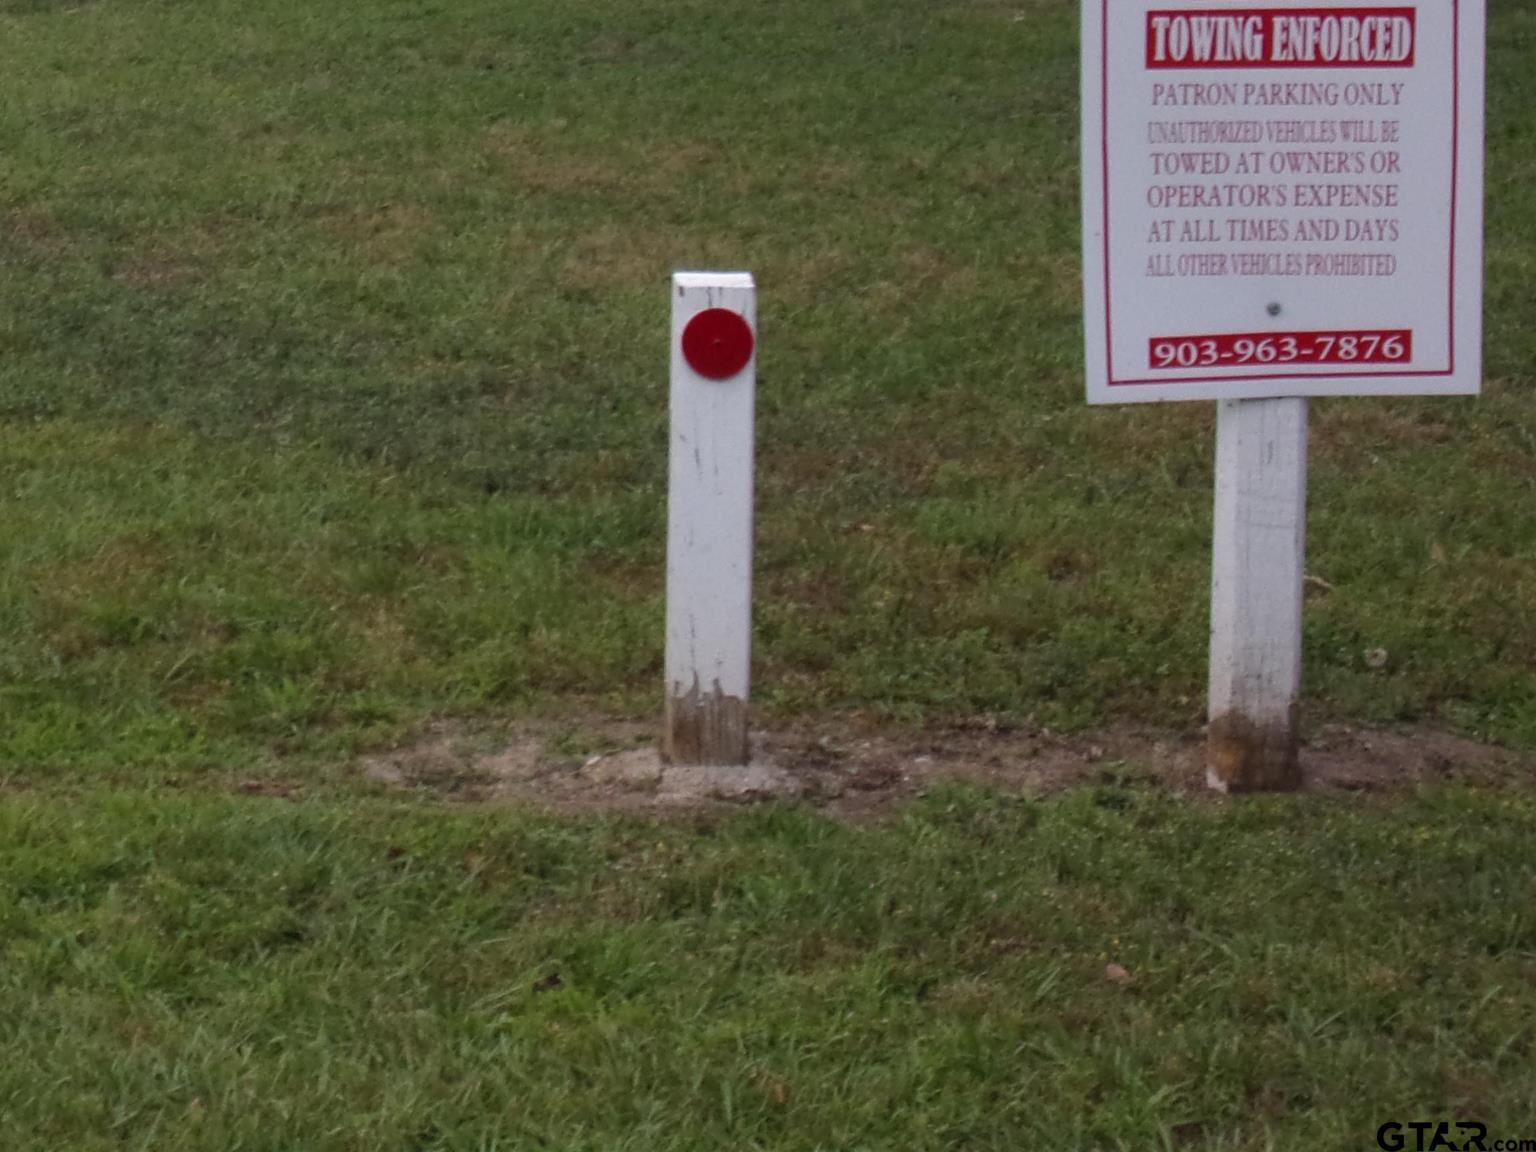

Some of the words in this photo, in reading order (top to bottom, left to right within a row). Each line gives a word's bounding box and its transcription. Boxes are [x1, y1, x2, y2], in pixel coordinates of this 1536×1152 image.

[1152, 16, 1264, 62] TOWING
[1270, 15, 1412, 62] ENFORCED
[1152, 83, 1238, 106] PATRON
[1243, 83, 1339, 106] PARKING
[1344, 82, 1405, 105] ONLY
[1266, 120, 1338, 143] VEHICLES
[1339, 120, 1377, 142] WILL
[1381, 120, 1401, 142] BE
[1150, 152, 1230, 176] TOWED
[1235, 152, 1265, 175] AT
[1270, 151, 1365, 174] OWNER'S
[1370, 151, 1401, 173] OR
[1146, 185, 1287, 208] OPERATOR'S
[1293, 184, 1399, 207] EXPENSE
[1147, 220, 1176, 243] AT
[1180, 220, 1222, 242] ALL
[1226, 219, 1289, 242] TIMES
[1294, 219, 1340, 241] AND
[1344, 219, 1400, 241] DAYS
[1146, 254, 1175, 277] ALL
[1177, 254, 1229, 276] OTHER
[1230, 254, 1304, 276] VEHICLES
[1305, 254, 1398, 276] PROHIBITED
[1154, 335, 1405, 367] 903-963-7876
